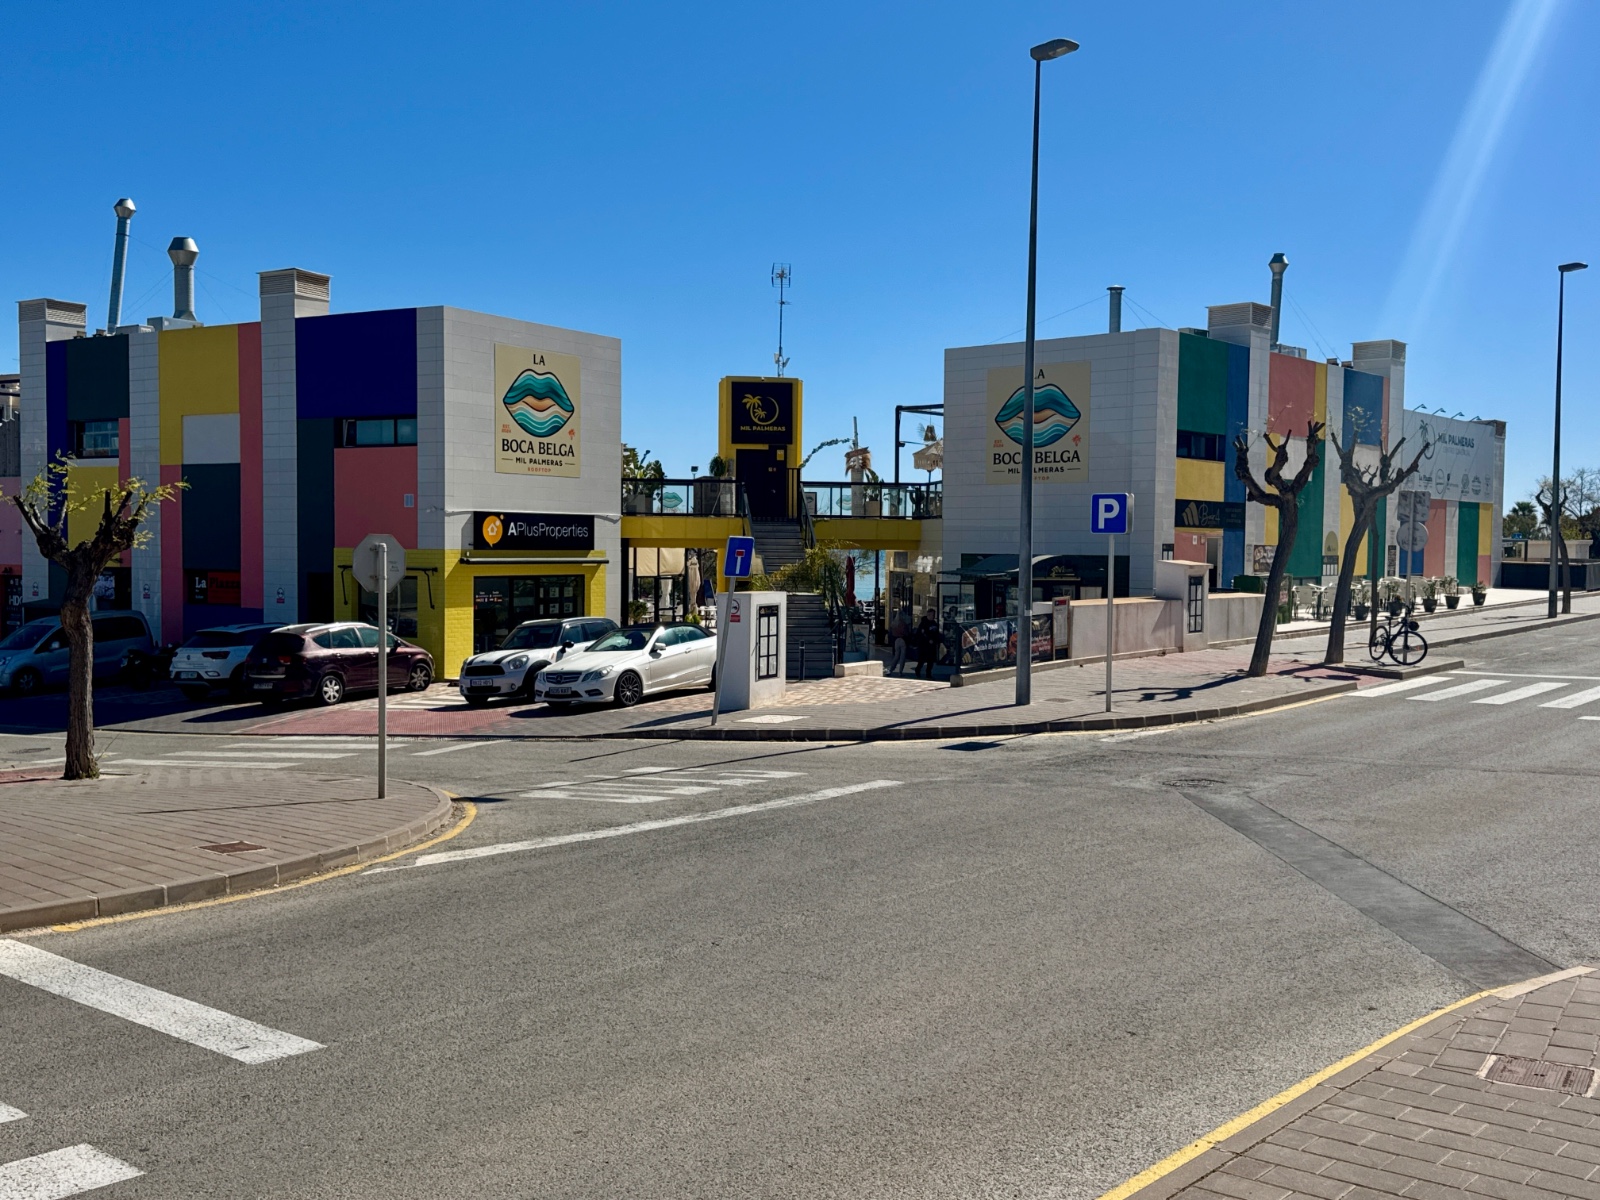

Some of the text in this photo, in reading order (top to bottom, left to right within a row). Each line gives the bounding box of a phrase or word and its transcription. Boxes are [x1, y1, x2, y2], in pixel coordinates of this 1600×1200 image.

[533, 354, 546, 366] LA
[502, 438, 575, 457] BOCA BELGA
[1448, 434, 1475, 448] PALMERAS
[529, 457, 563, 467] PALMERAS
[993, 449, 1081, 465] BOC BELGA
[1033, 466, 1065, 474] LMERAS
[1098, 498, 1120, 530] P
[507, 522, 589, 540] APlusProperties
[195, 577, 207, 588] La
